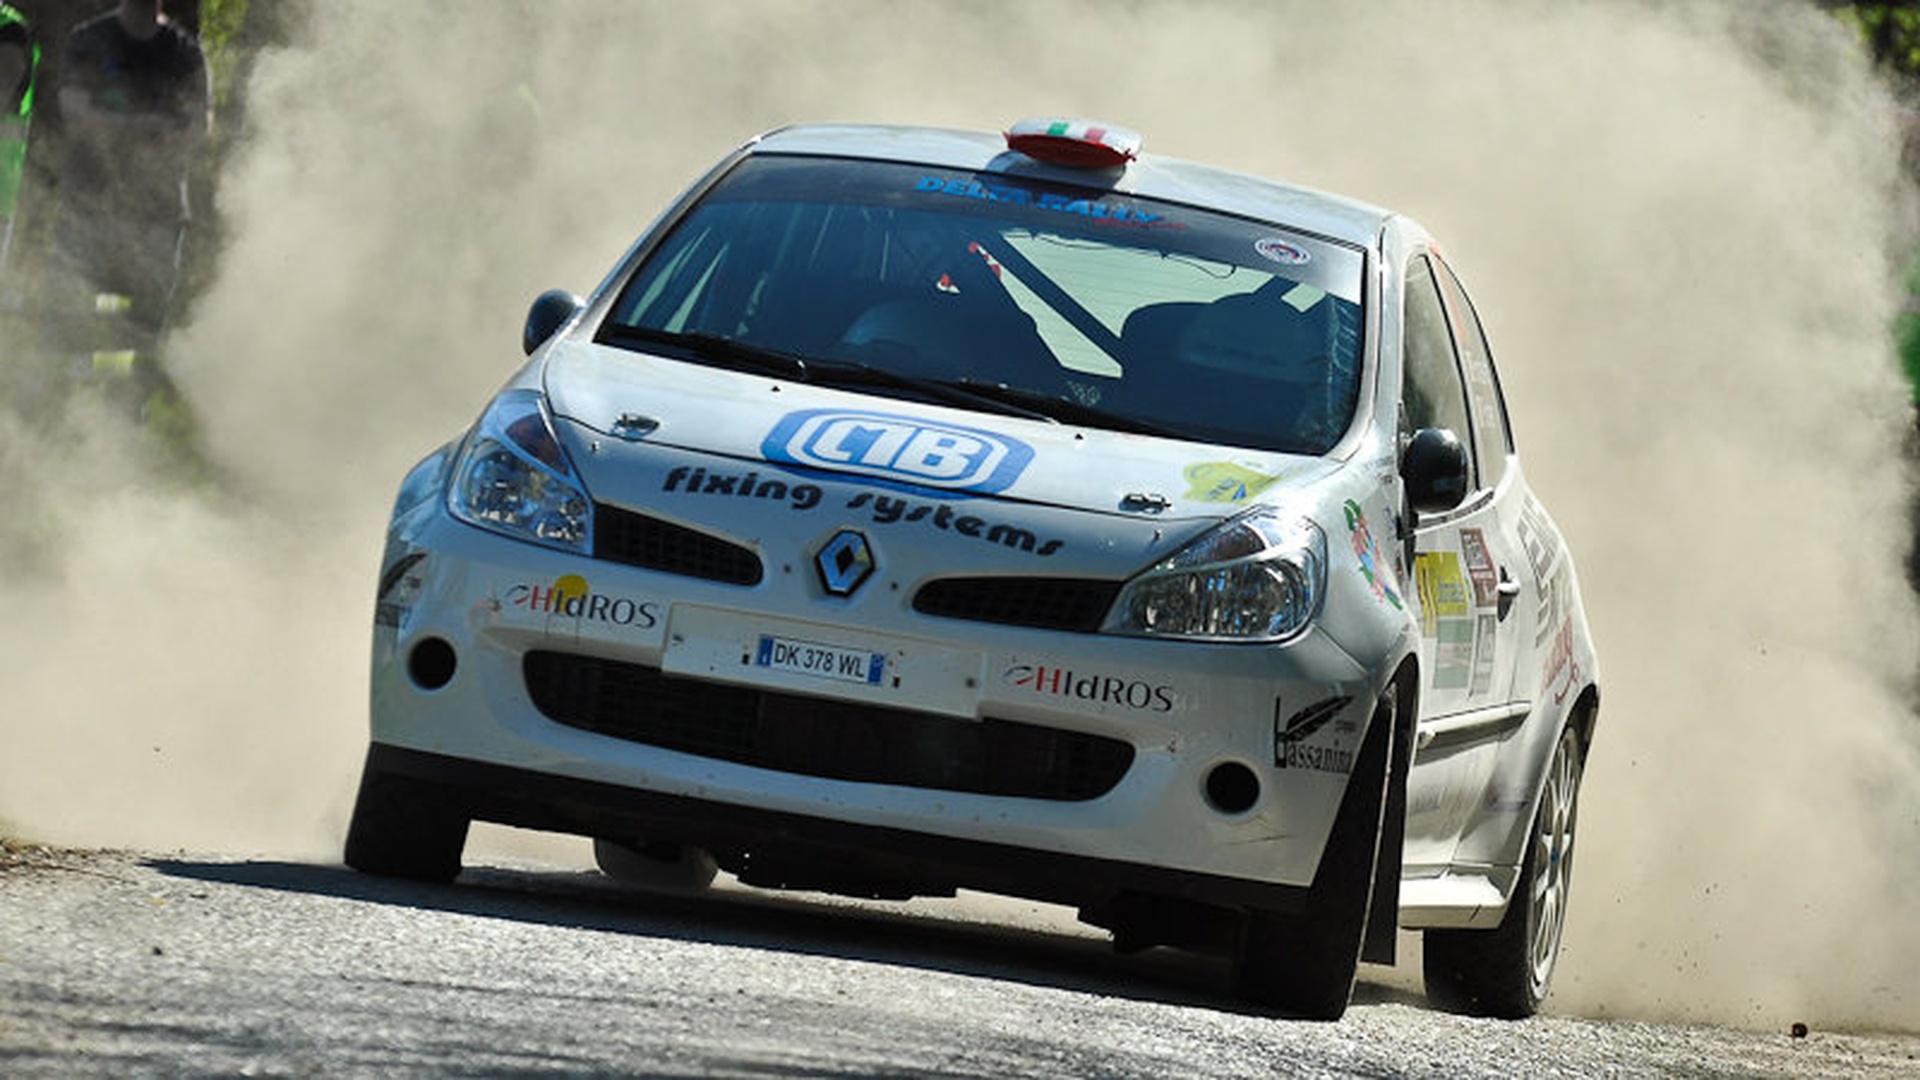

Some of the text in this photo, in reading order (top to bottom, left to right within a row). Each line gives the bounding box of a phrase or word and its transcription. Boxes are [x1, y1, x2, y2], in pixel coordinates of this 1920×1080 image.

[914, 175, 1033, 205] DELTA
[1036, 192, 1165, 223] RALLY
[662, 465, 1065, 557] fixing systems
[774, 643, 866, 679] DK 378 WL
